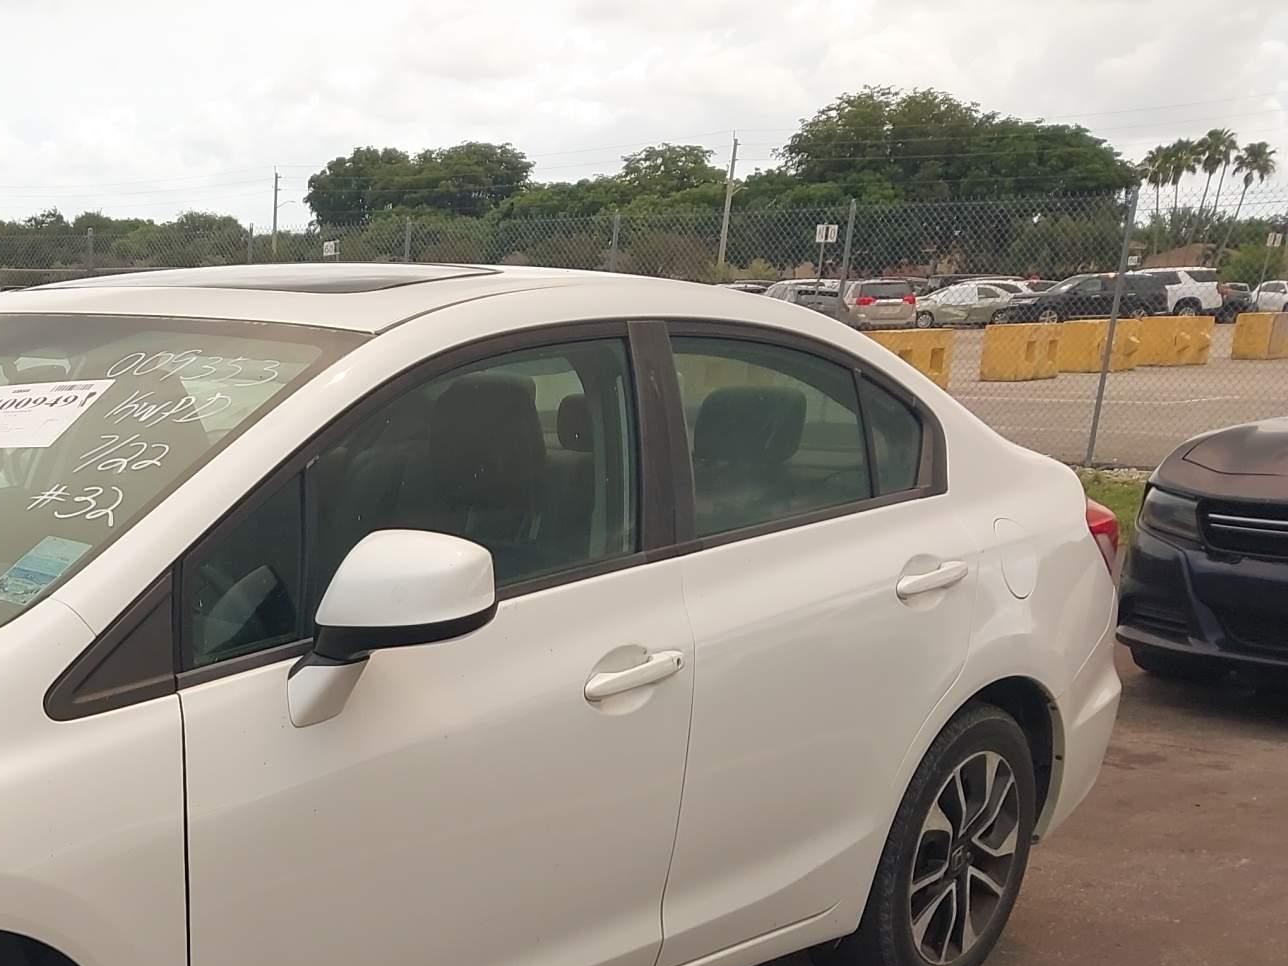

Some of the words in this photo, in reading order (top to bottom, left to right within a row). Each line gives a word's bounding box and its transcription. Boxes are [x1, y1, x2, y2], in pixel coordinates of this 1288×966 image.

[106, 349, 280, 387] 009353
[72, 433, 170, 474] 7/22
[26, 483, 124, 527] #32
